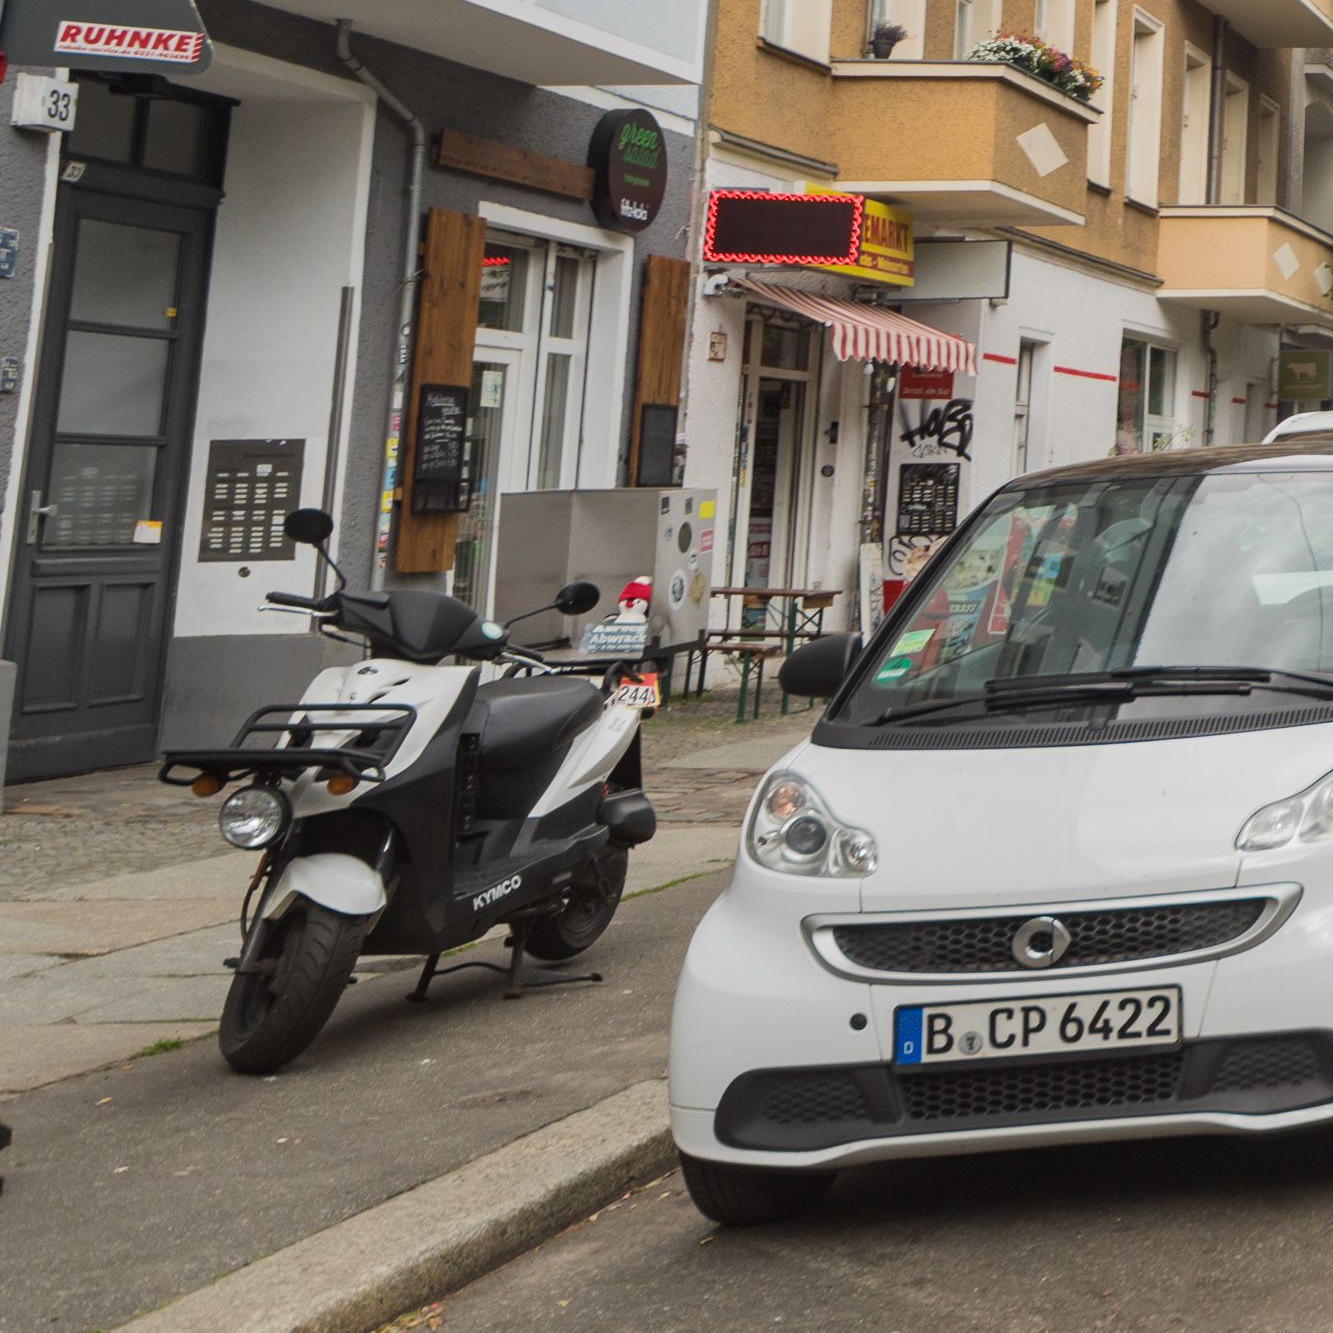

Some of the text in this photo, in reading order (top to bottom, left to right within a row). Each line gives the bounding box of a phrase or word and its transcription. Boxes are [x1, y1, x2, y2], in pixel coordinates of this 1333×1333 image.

[60, 24, 193, 53] RUHNKE
[48, 89, 71, 121] 33
[618, 123, 657, 150] green
[473, 874, 522, 911] KYMCO
[926, 995, 1172, 1055] B CP 6422
